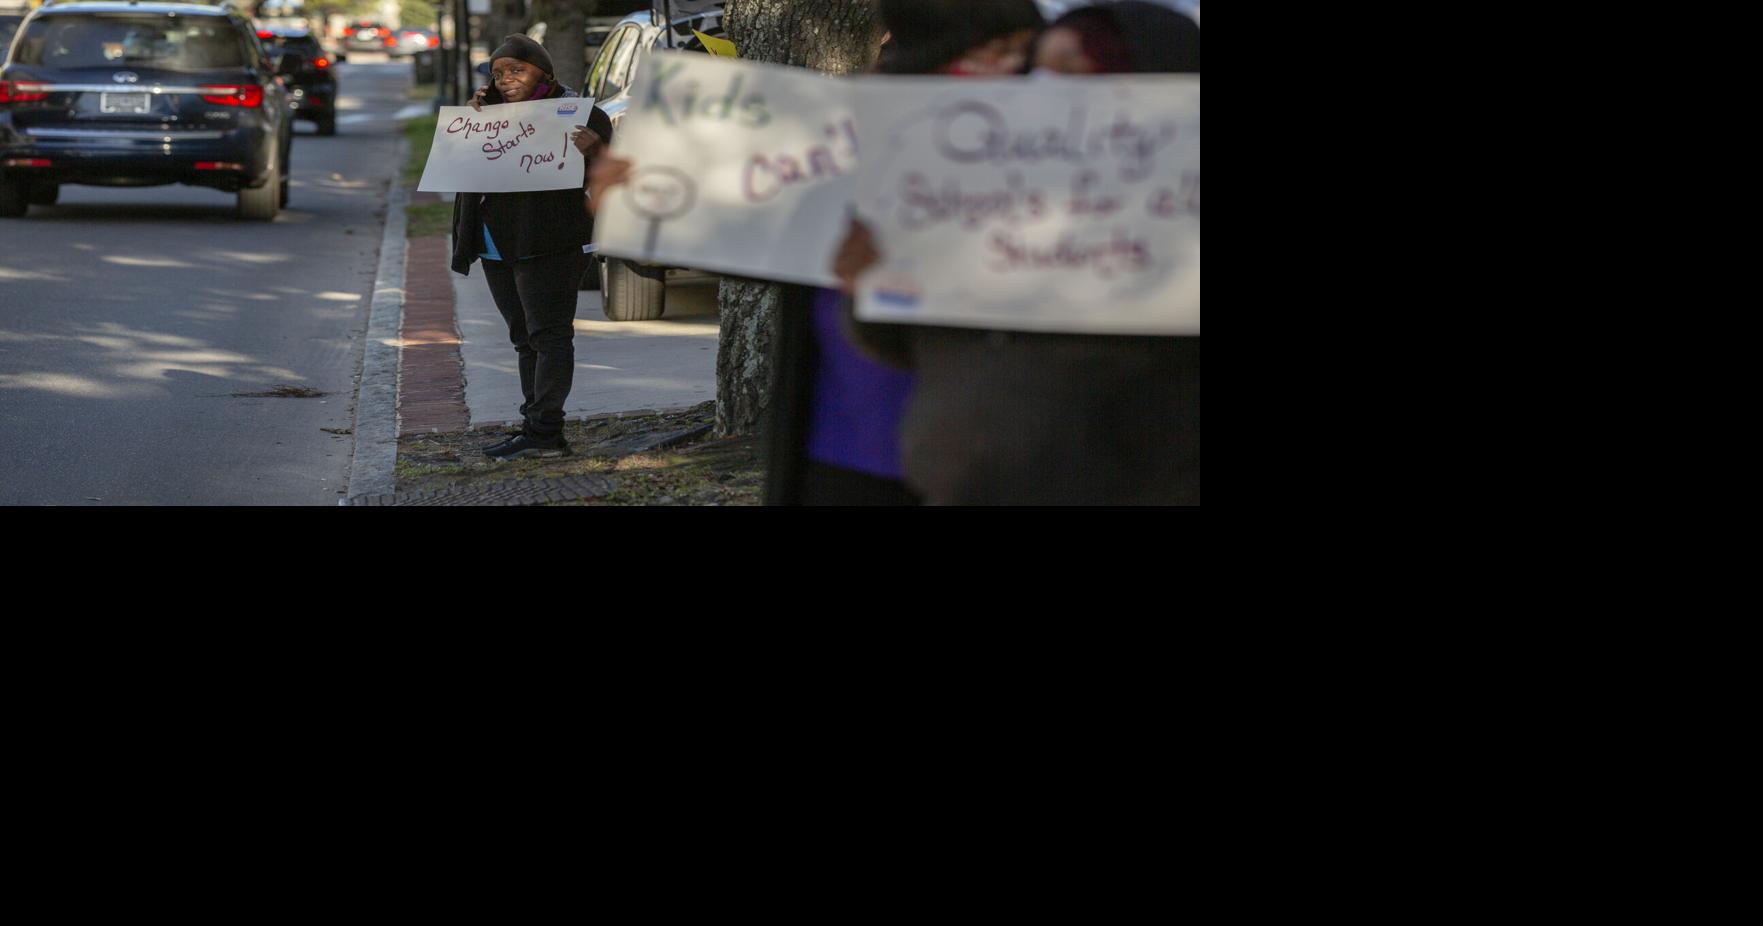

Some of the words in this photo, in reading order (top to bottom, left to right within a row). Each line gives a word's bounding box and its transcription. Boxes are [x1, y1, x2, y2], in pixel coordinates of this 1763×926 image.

[642, 61, 771, 128] Kids
[447, 117, 509, 139] Change
[482, 123, 536, 160] Starts
[932, 100, 1172, 182] Quality
[1070, 169, 1123, 215] for
